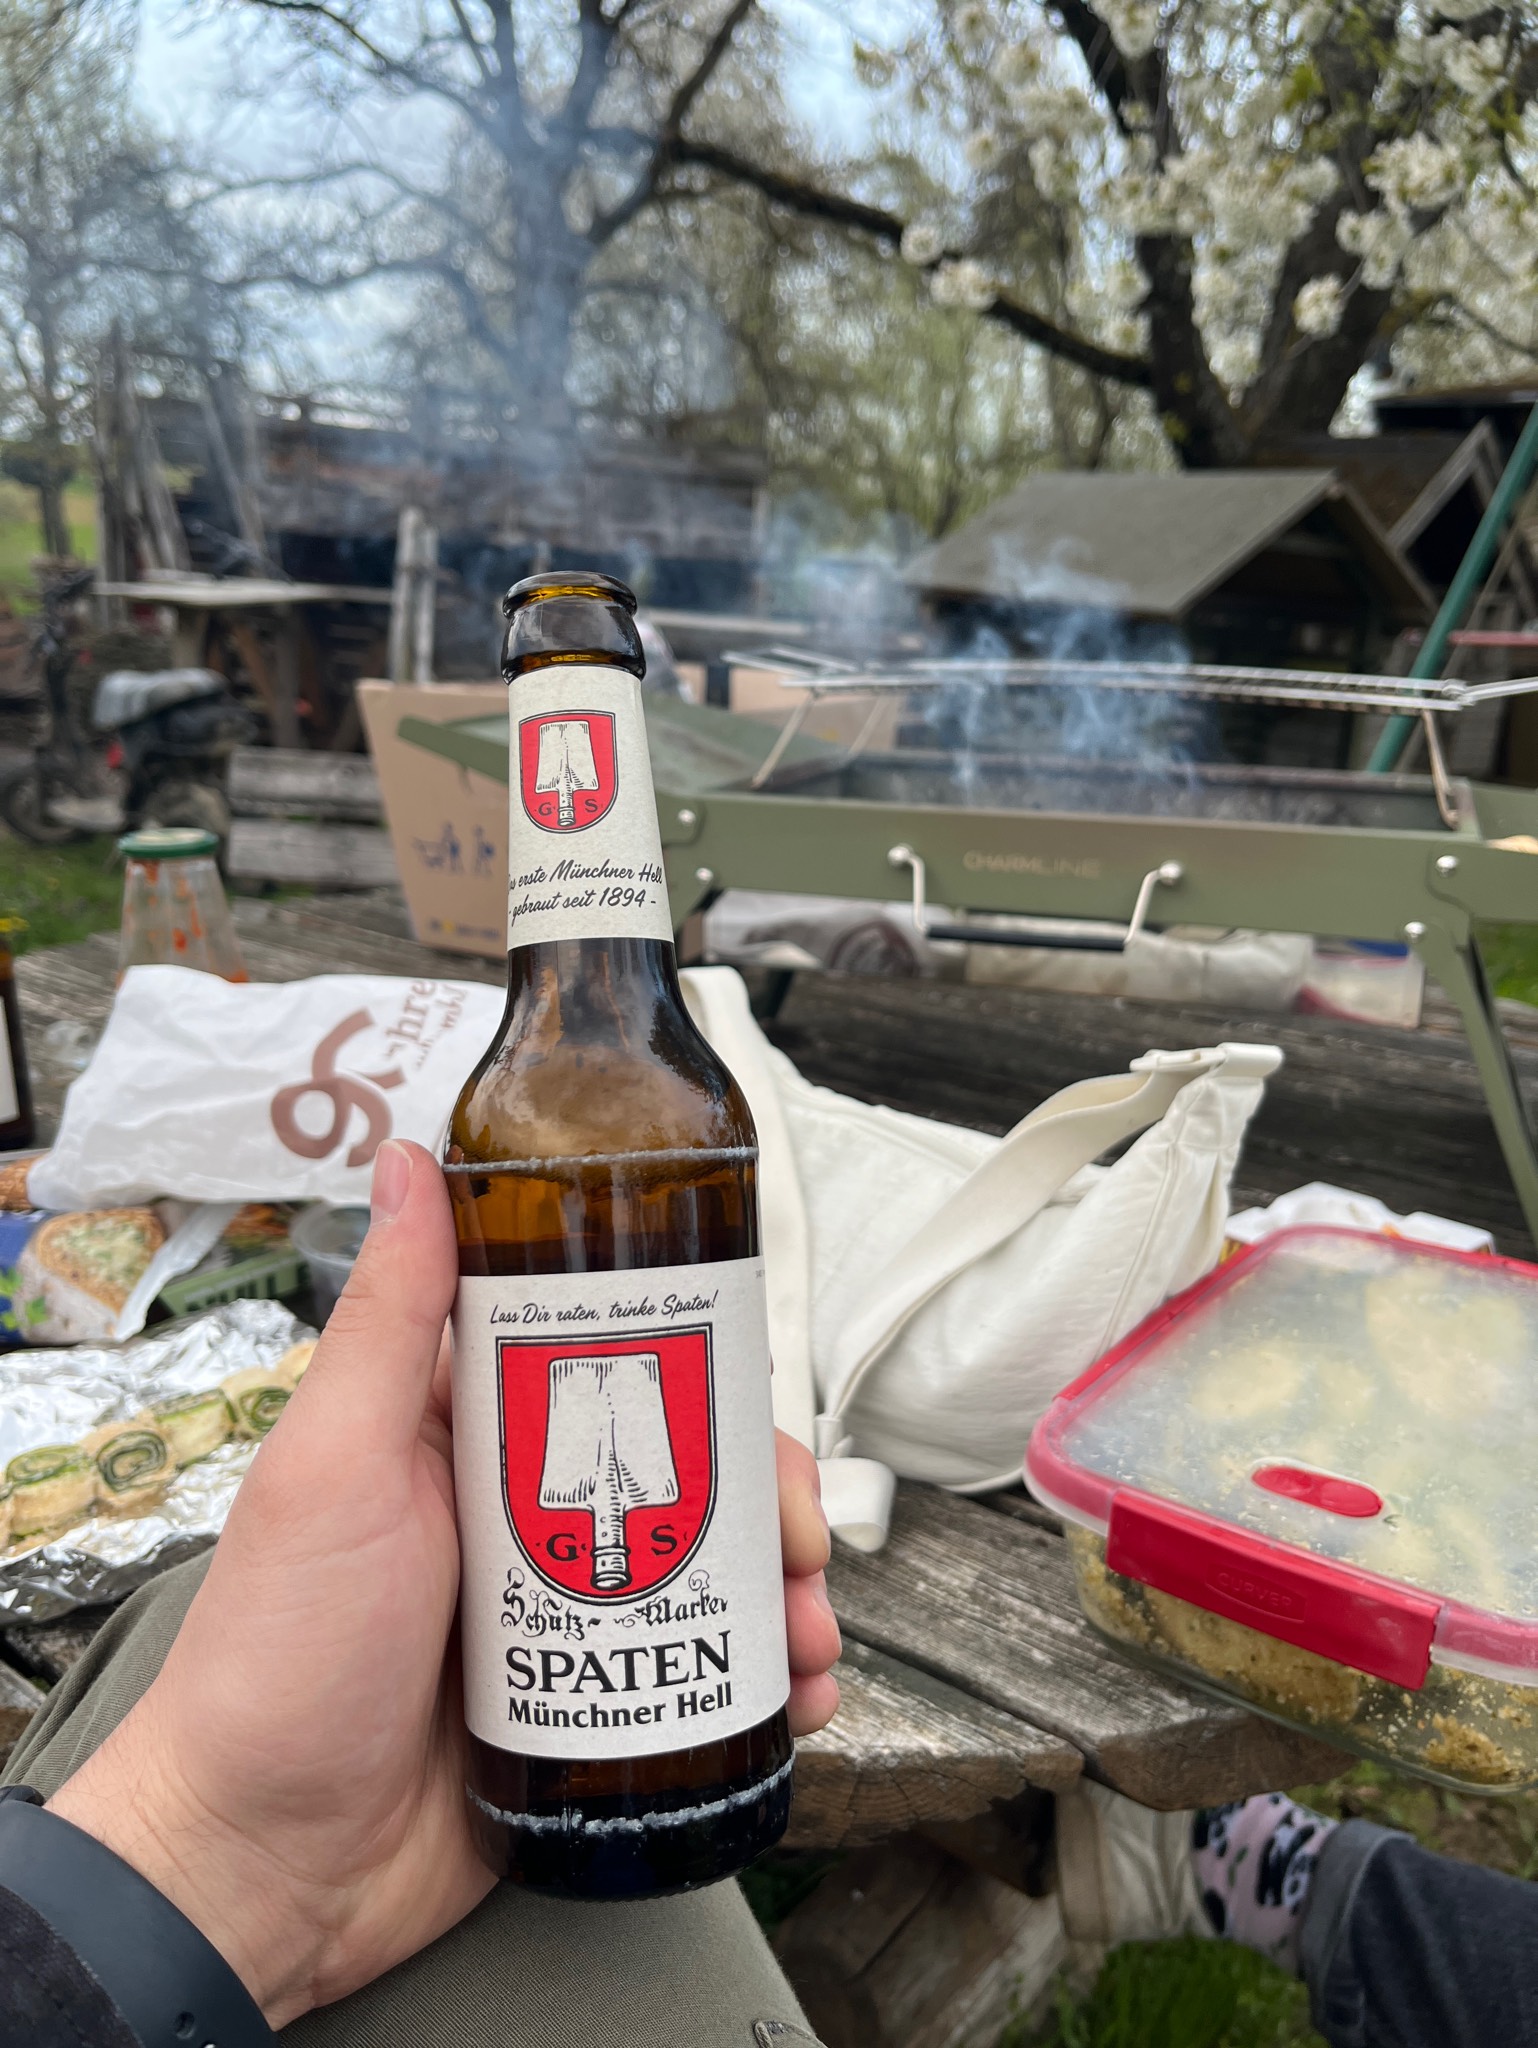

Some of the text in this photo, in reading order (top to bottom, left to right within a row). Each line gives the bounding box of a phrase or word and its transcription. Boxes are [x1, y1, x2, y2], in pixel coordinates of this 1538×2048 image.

[538, 798, 599, 816] G S
[518, 866, 547, 888] erste
[549, 859, 636, 882] Münchner
[638, 863, 663, 884] Hell
[562, 890, 597, 907] seit
[599, 887, 646, 907] 1894
[490, 1289, 719, 1324] Lass Dir raten, trinke Spaten!
[547, 1525, 677, 1561] G S
[1216, 1572, 1293, 1610] CURVER
[505, 1630, 731, 1694] SPATEN
[507, 1681, 733, 1728] Münchner Hell
